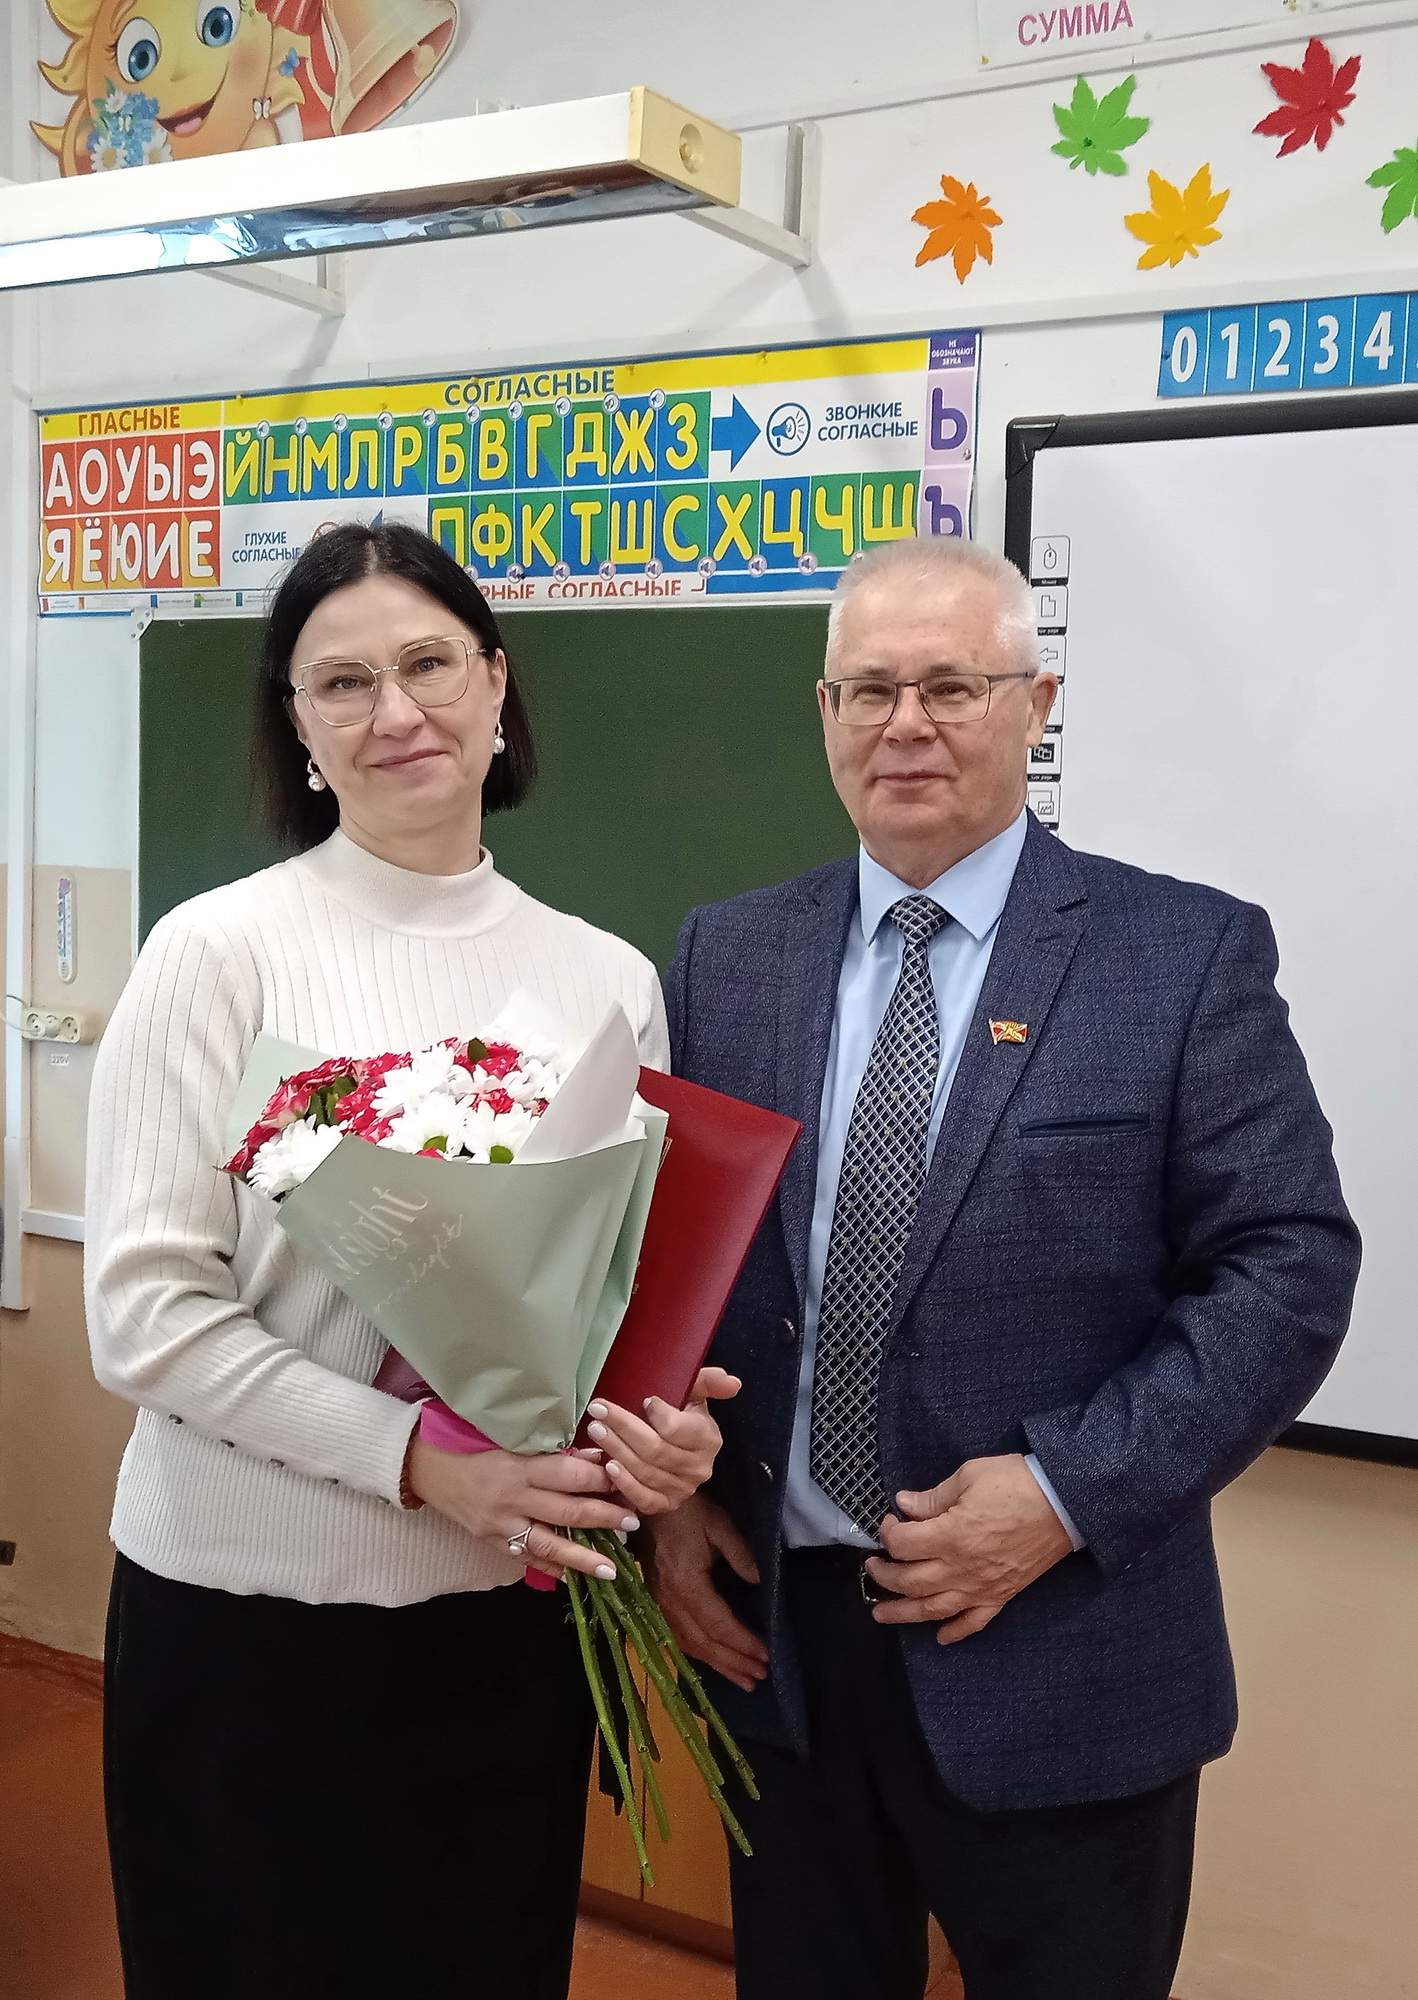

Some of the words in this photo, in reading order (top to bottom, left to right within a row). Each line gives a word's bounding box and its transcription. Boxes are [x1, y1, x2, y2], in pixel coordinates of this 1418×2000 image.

[1018, 0, 1134, 46] СУММА
[445, 370, 615, 406] СОГЛАСНЫЕ
[78, 406, 181, 437] ГЛАСНЫЕ
[825, 402, 903, 420] ЗВОНКИЕ
[817, 420, 918, 442] СОГЛАСНЫЕ
[244, 531, 287, 546] ГЛУХИЕ
[480, 583, 536, 600] РНЫЕ
[547, 579, 682, 598] СОГЛАСНЫЕ
